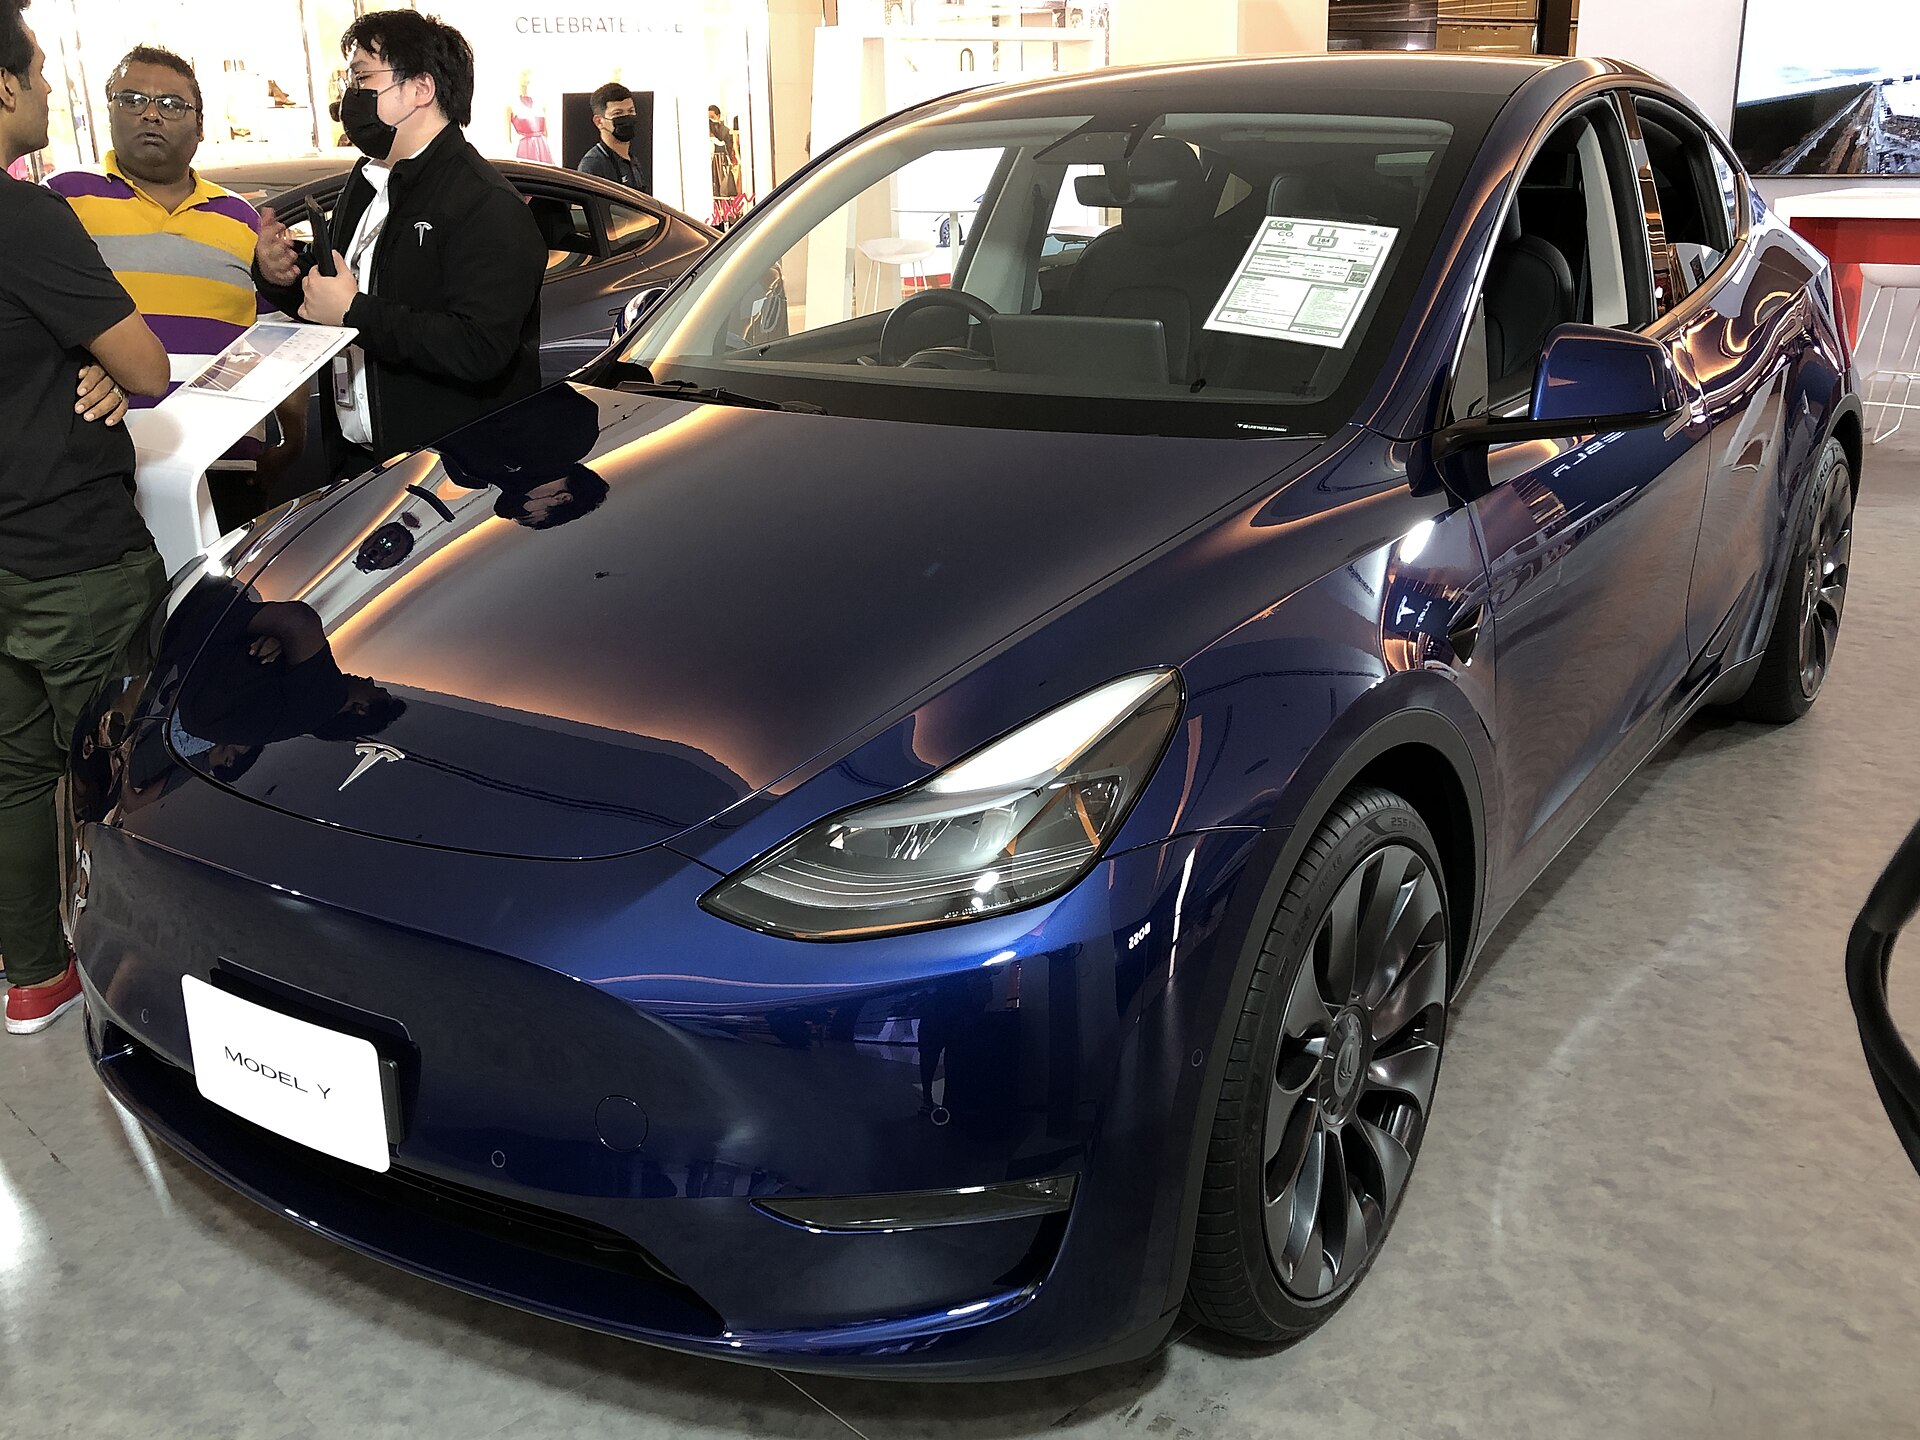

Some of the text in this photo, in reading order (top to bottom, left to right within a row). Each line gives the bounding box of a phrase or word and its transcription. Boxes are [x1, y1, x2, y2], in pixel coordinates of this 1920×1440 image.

[516, 16, 628, 34] CELEBRATE
[225, 1045, 331, 1100] MODEL Y
